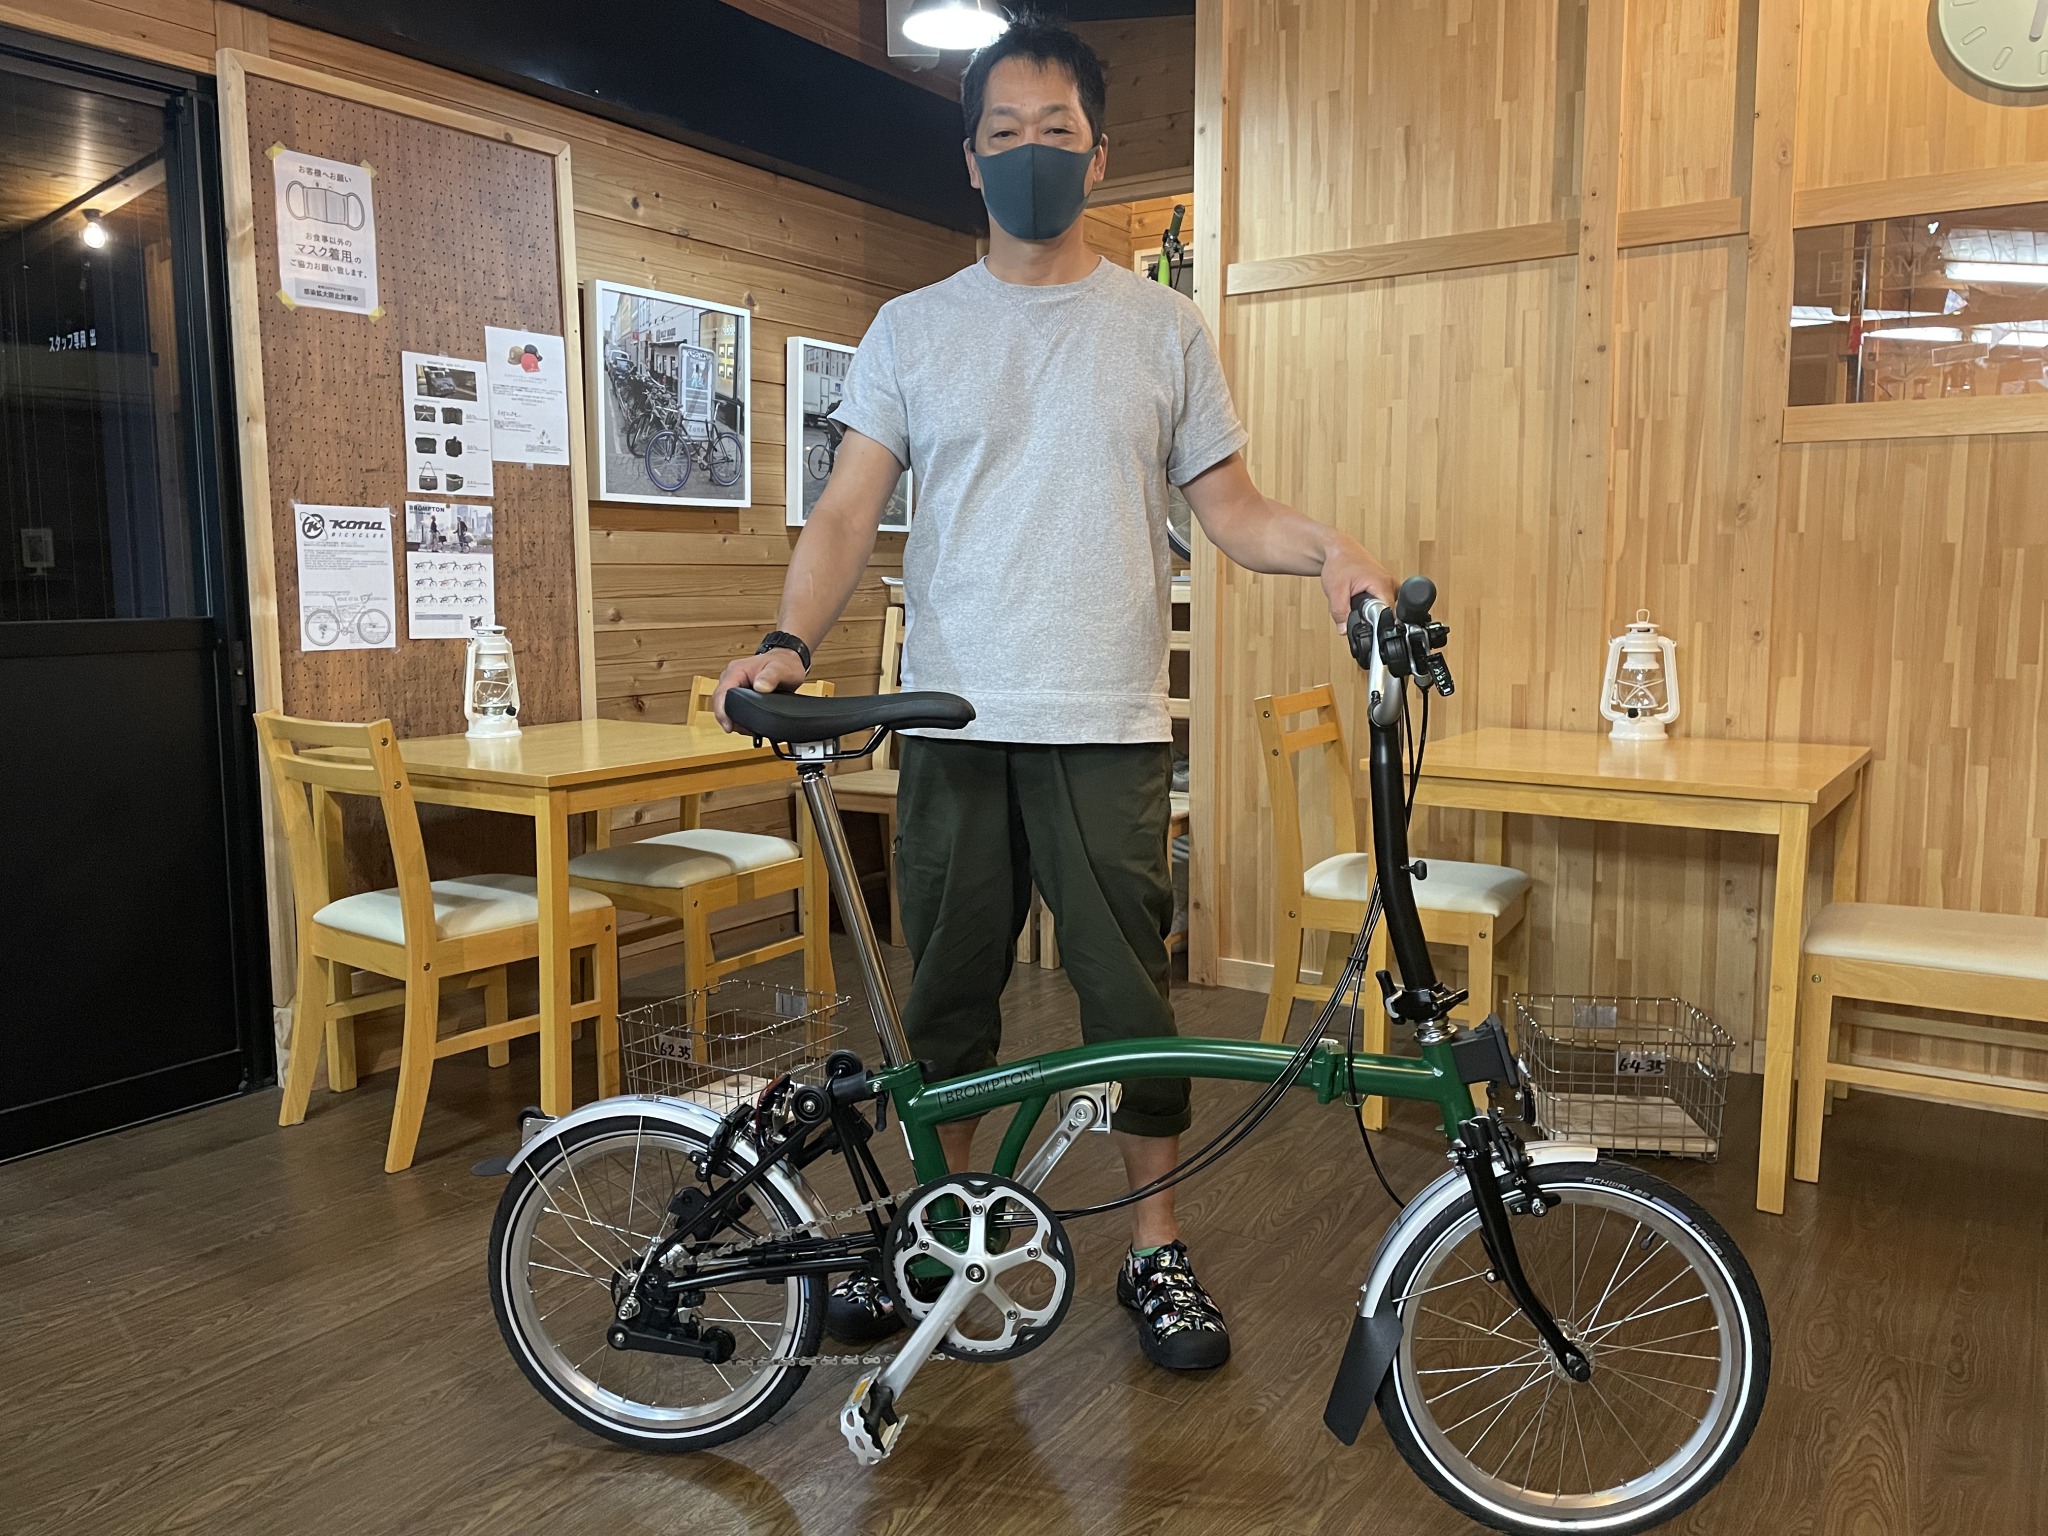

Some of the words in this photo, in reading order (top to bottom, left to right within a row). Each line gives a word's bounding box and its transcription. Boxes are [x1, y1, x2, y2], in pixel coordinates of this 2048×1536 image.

[298, 165, 352, 182] お客様へお願い
[305, 232, 352, 247] お食事以外の
[296, 243, 361, 264] マスク着用の
[48, 330, 86, 352] スタッフ専用
[944, 1068, 1036, 1104] BROMPTON
[1584, 1176, 1651, 1199] SCHWALBE
[1691, 1223, 1724, 1256] RACER
